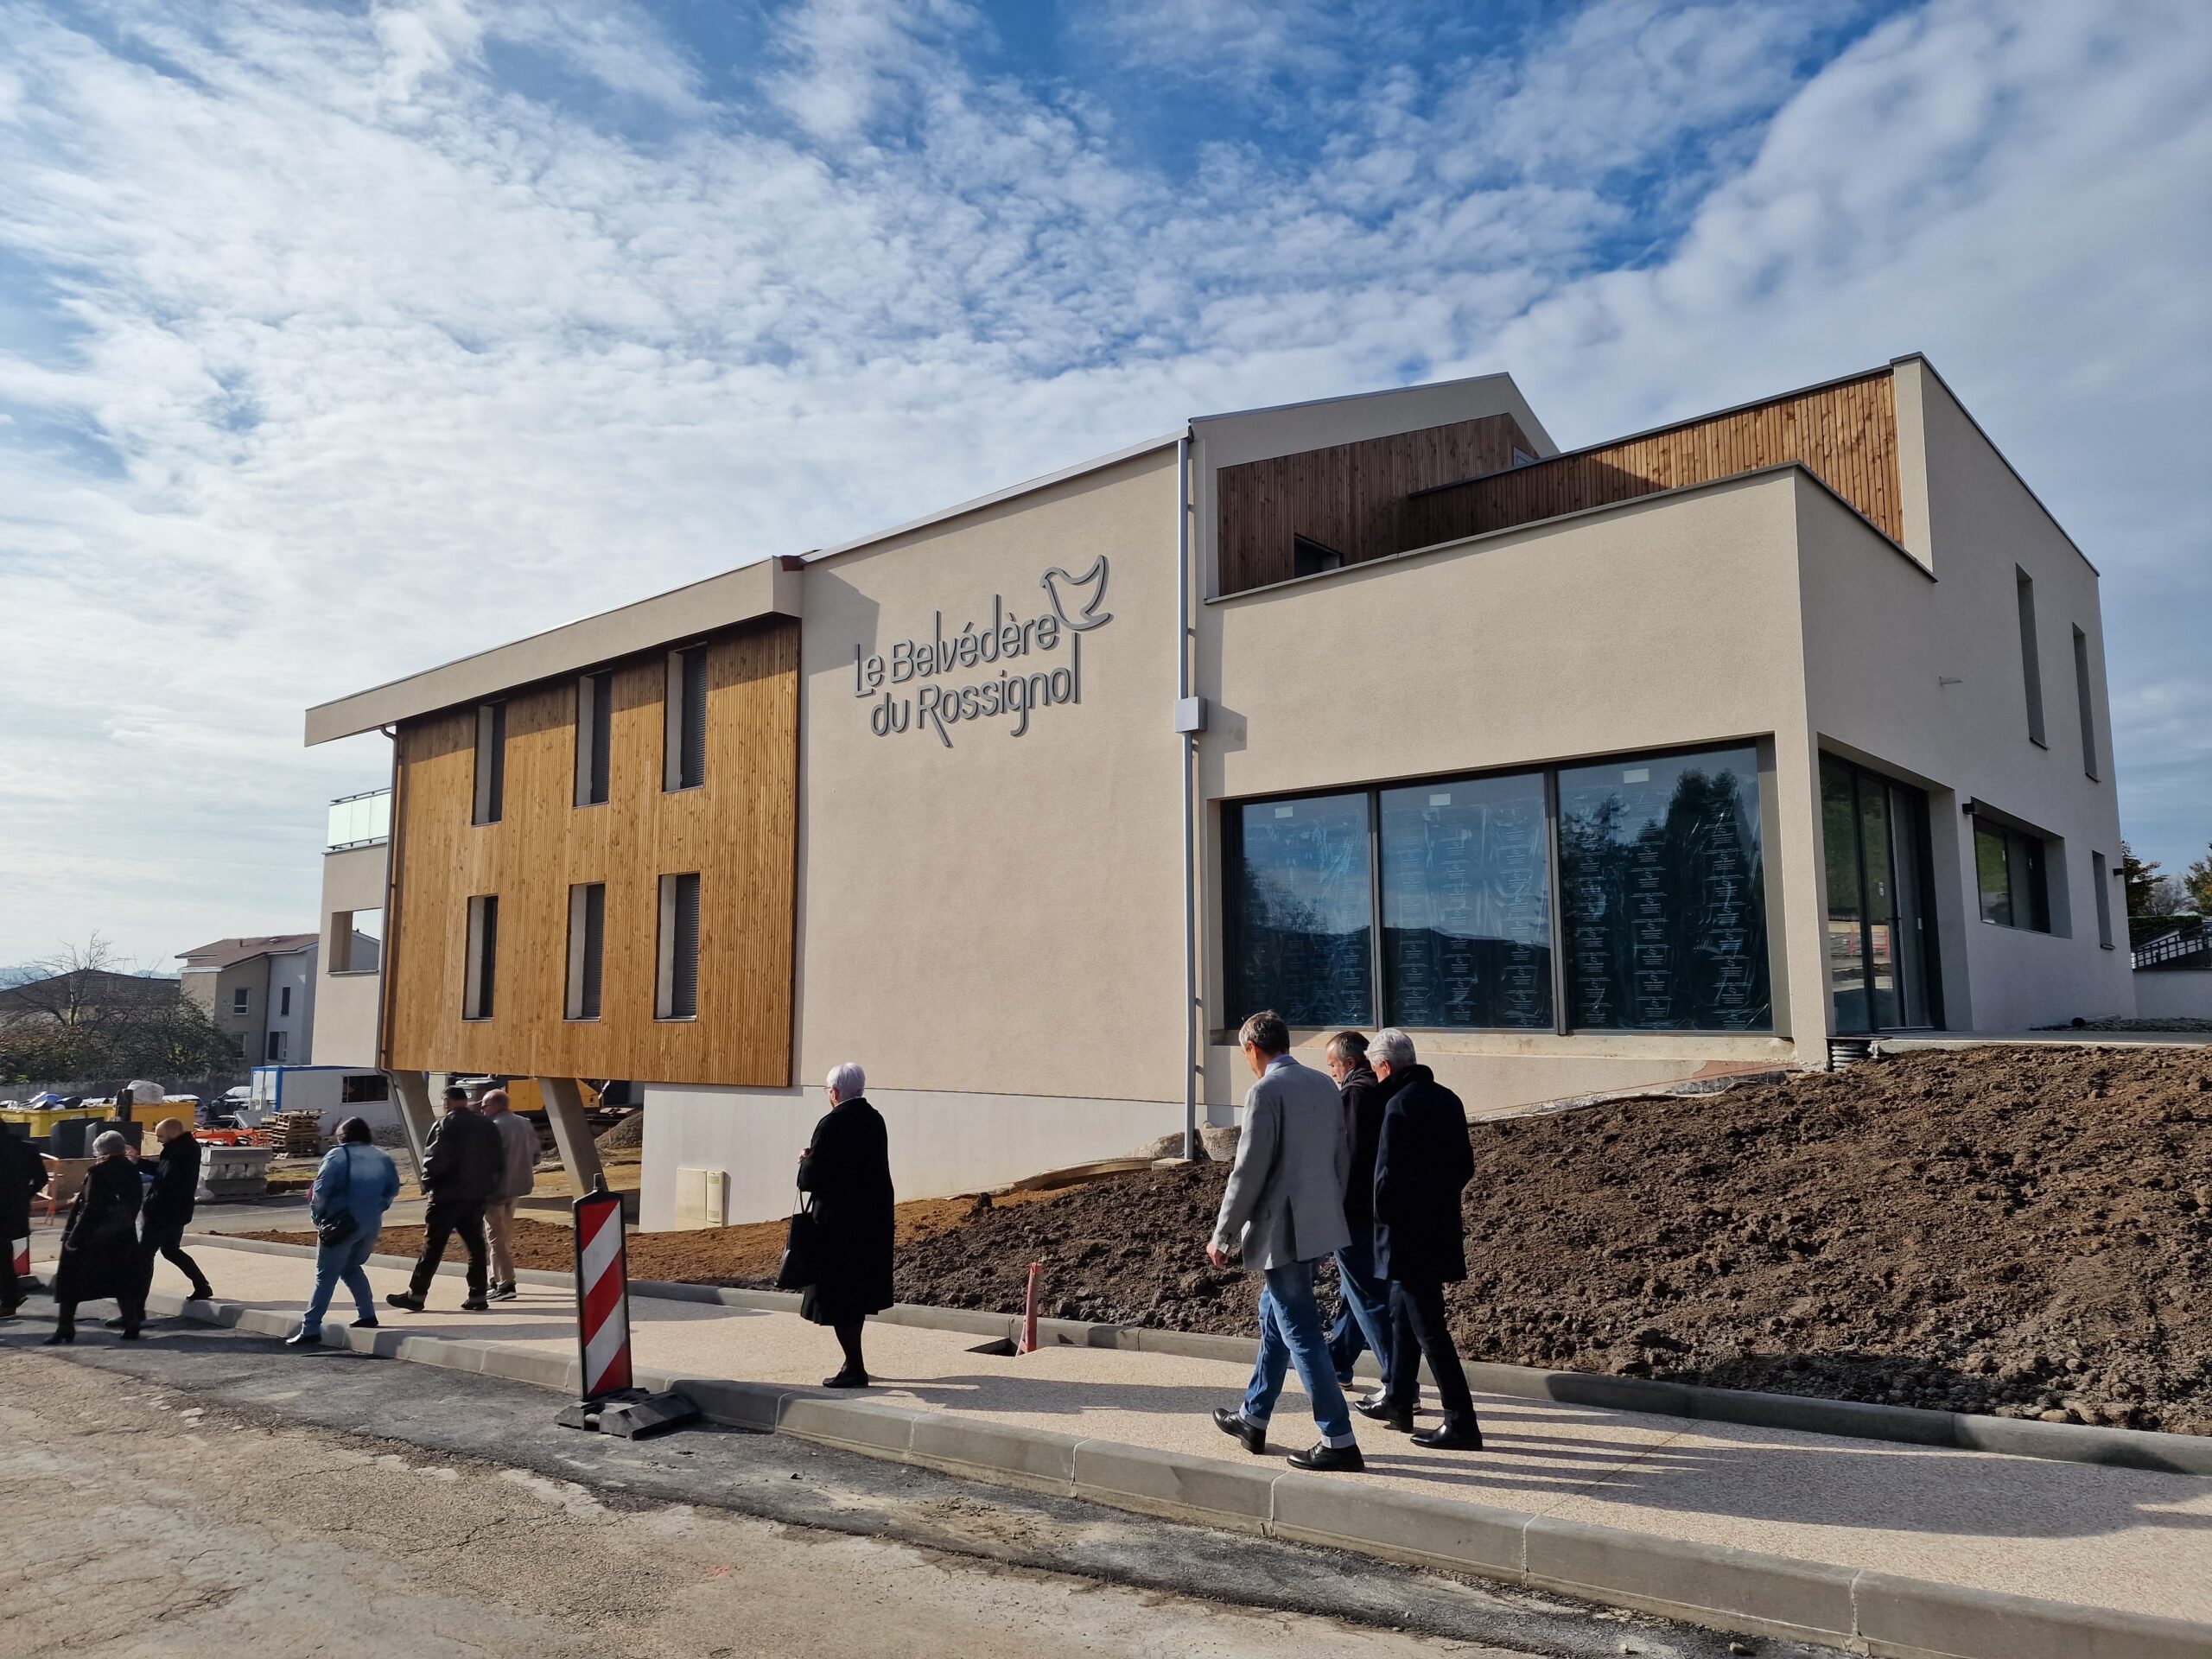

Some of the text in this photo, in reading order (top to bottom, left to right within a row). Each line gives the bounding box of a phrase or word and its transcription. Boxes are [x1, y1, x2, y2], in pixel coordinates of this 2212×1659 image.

[855, 594, 1059, 697] Le Belvédère
[871, 632, 1080, 747] du Rossignol
